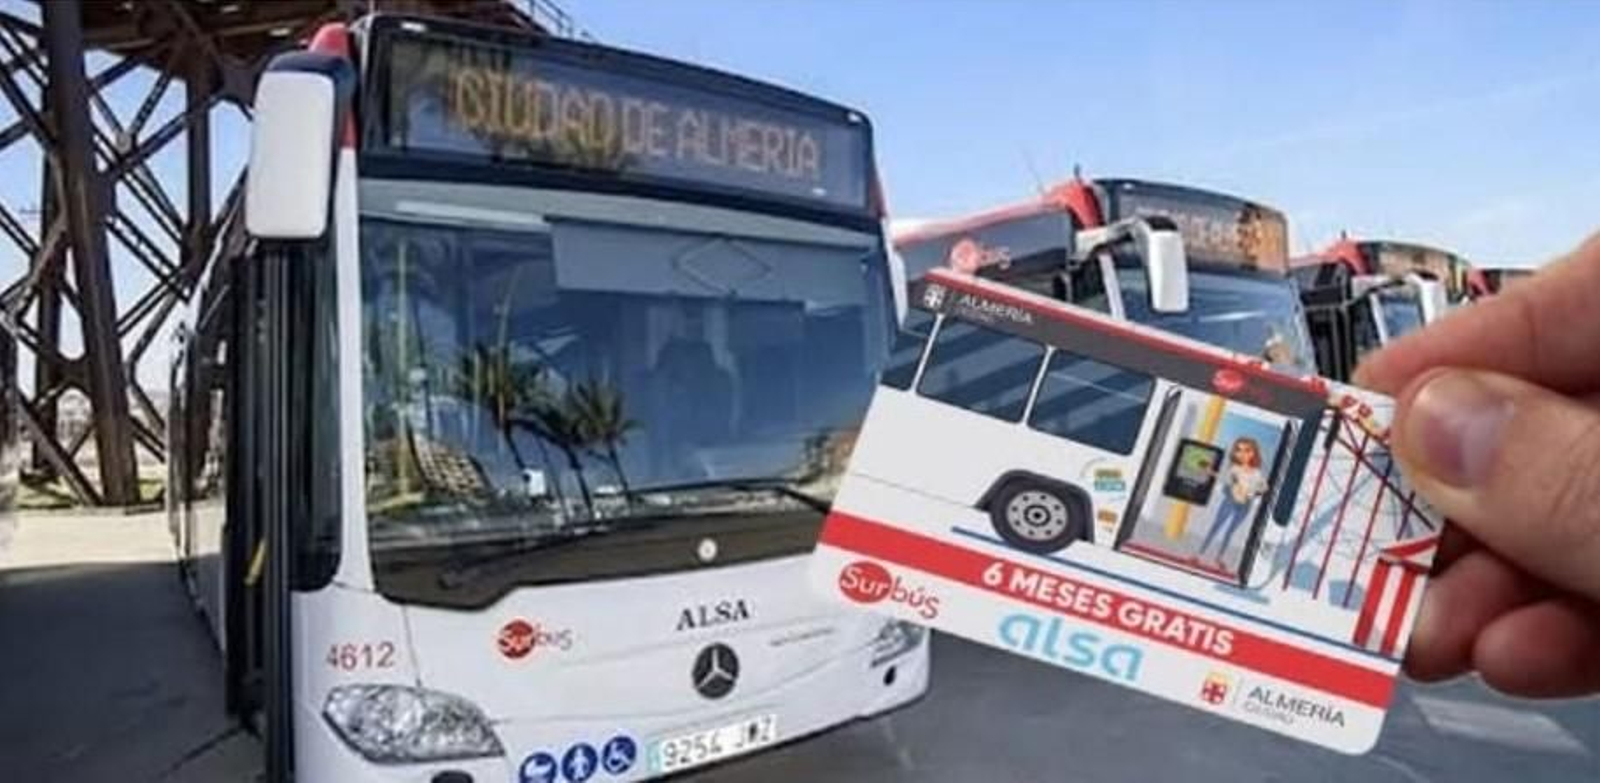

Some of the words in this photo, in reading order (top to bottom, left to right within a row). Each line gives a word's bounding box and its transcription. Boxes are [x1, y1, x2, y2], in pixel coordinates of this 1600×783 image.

[454, 67, 614, 151] CIUDAD
[621, 98, 672, 156] DE
[675, 109, 821, 178] ALMERIA
[677, 599, 750, 631] ALSA
[982, 561, 1004, 586] 6
[1008, 567, 1113, 618] MESES
[1117, 602, 1235, 655] GRATIS
[327, 641, 396, 671] 4612
[998, 612, 1144, 681] alsa
[662, 731, 723, 768] 9254
